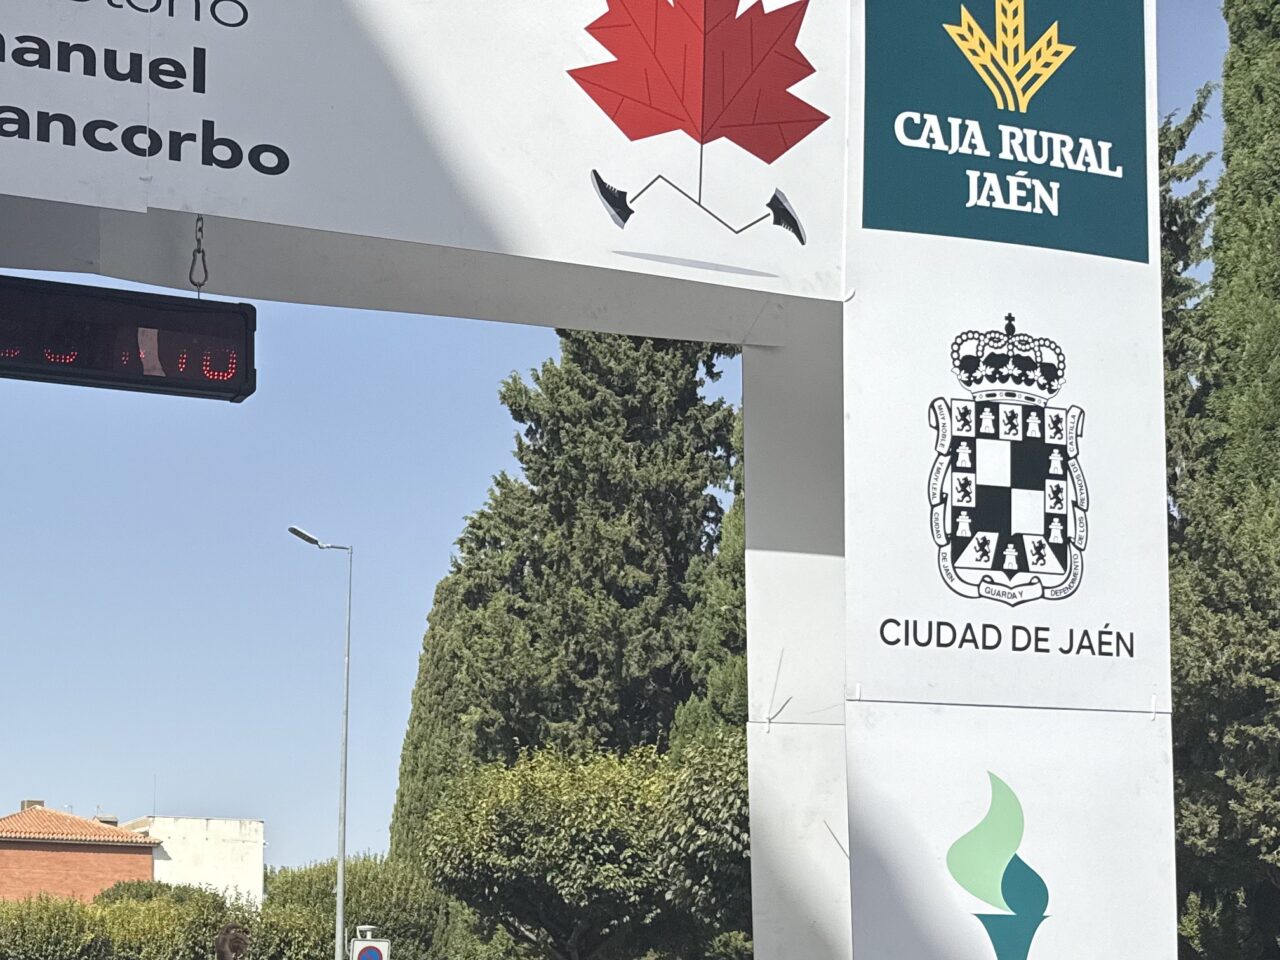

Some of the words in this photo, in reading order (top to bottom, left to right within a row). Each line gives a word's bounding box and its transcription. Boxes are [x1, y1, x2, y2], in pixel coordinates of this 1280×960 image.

[894, 111, 990, 157] CAJA
[999, 124, 1123, 178] RURAL
[965, 170, 1060, 216] JAÉN
[984, 586, 1018, 599] GUARDA
[879, 618, 1002, 650] CIUDAD
[1011, 625, 1051, 654] DE
[1058, 624, 1135, 658] JAÉN
